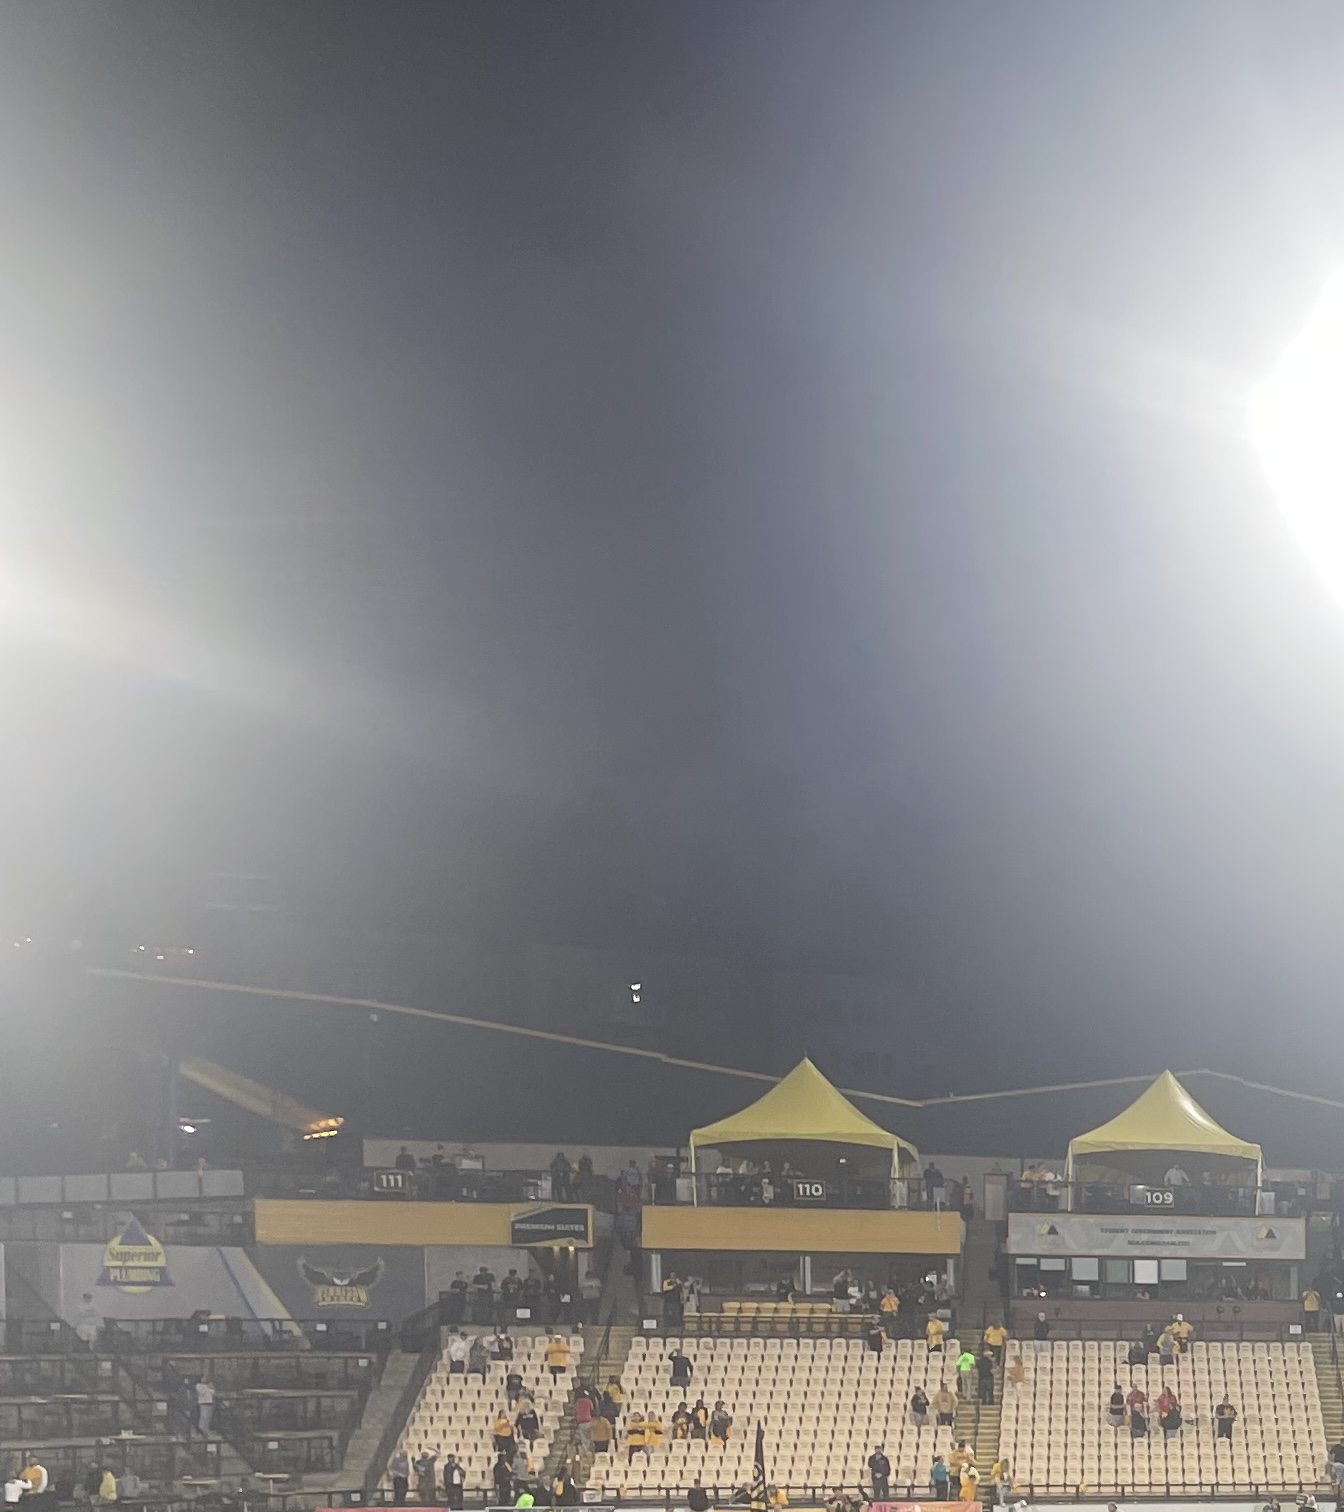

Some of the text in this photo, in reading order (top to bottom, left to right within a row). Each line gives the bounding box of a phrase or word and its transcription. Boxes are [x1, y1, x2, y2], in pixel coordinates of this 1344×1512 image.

[380, 1174, 402, 1188] 111
[797, 1183, 823, 1197] 110
[1145, 1191, 1173, 1205] 109
[108, 1248, 162, 1265] Superior
